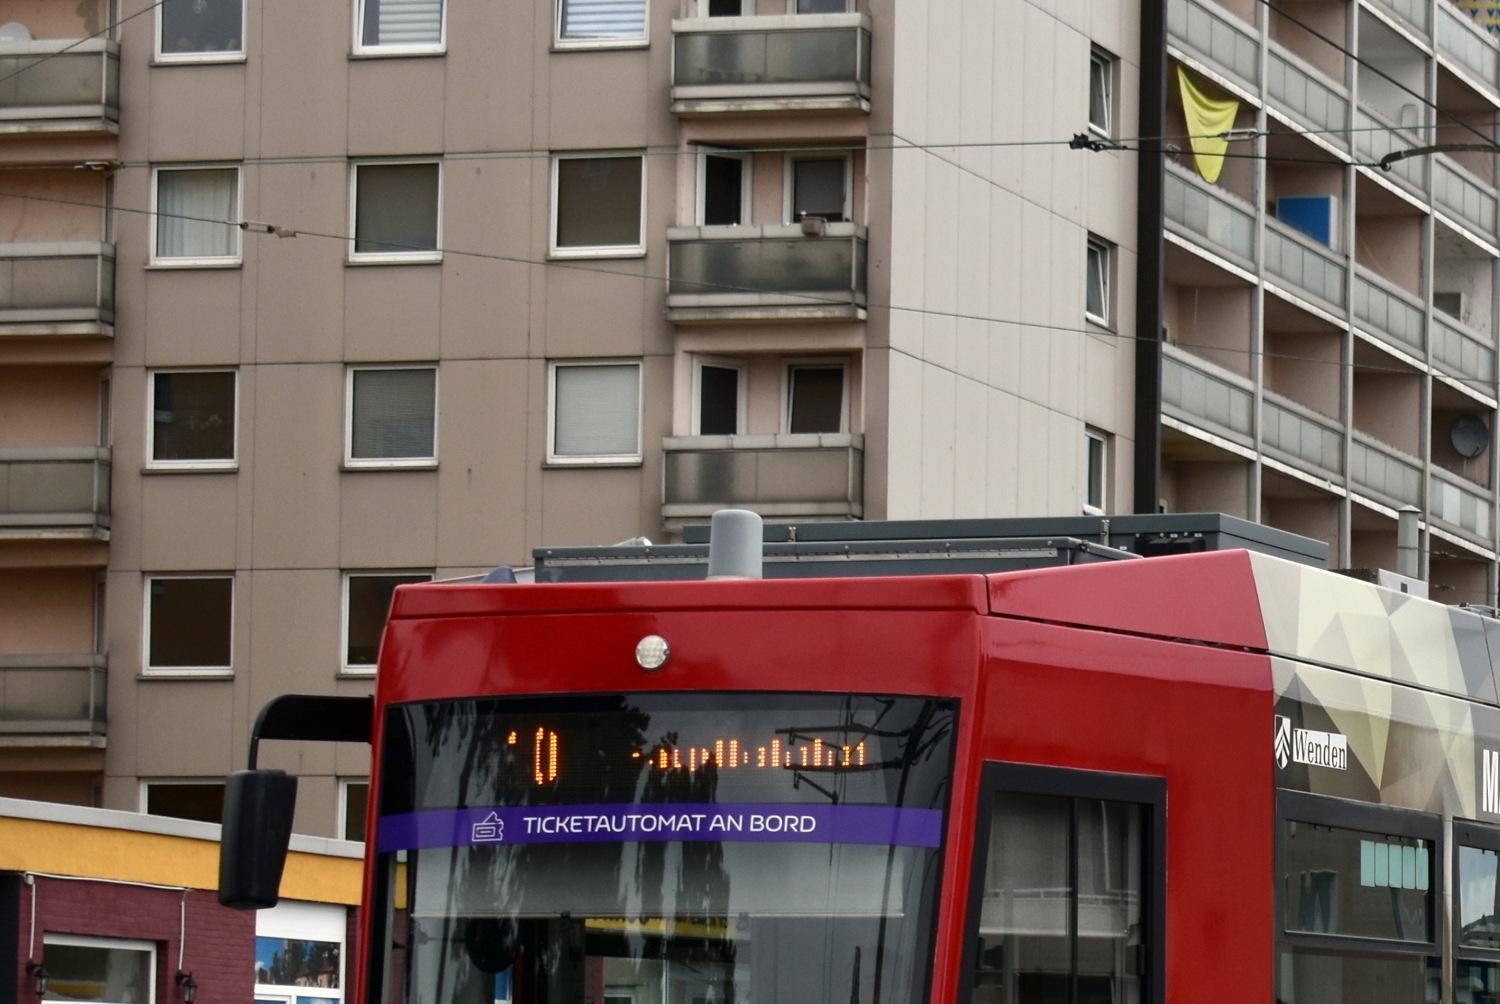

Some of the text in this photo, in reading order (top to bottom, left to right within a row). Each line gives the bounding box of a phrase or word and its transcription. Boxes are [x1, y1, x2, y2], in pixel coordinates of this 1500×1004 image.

[1295, 730, 1346, 769] Wenden
[523, 814, 816, 834] TICKETAUTOMAT AN BORD
